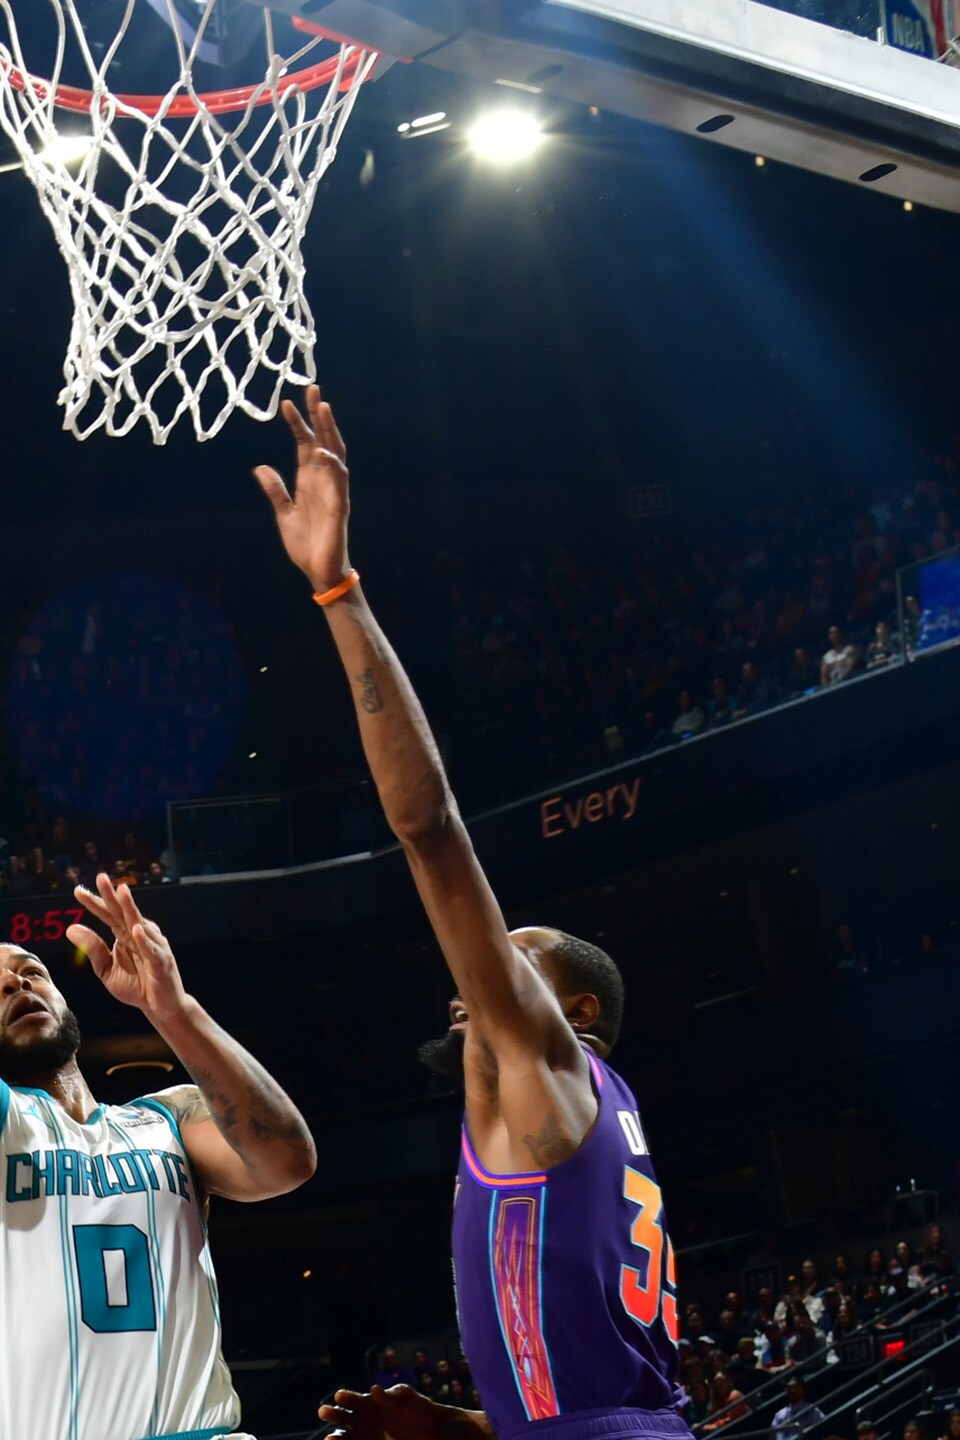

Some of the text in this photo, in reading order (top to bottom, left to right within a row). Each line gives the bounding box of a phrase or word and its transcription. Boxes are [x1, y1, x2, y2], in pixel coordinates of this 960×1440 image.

[892, 12, 925, 52] NBA
[541, 777, 641, 838] Every
[11, 908, 85, 943] 8:57
[617, 1110, 650, 1156] D
[5, 1148, 191, 1204] CHARLOTTE
